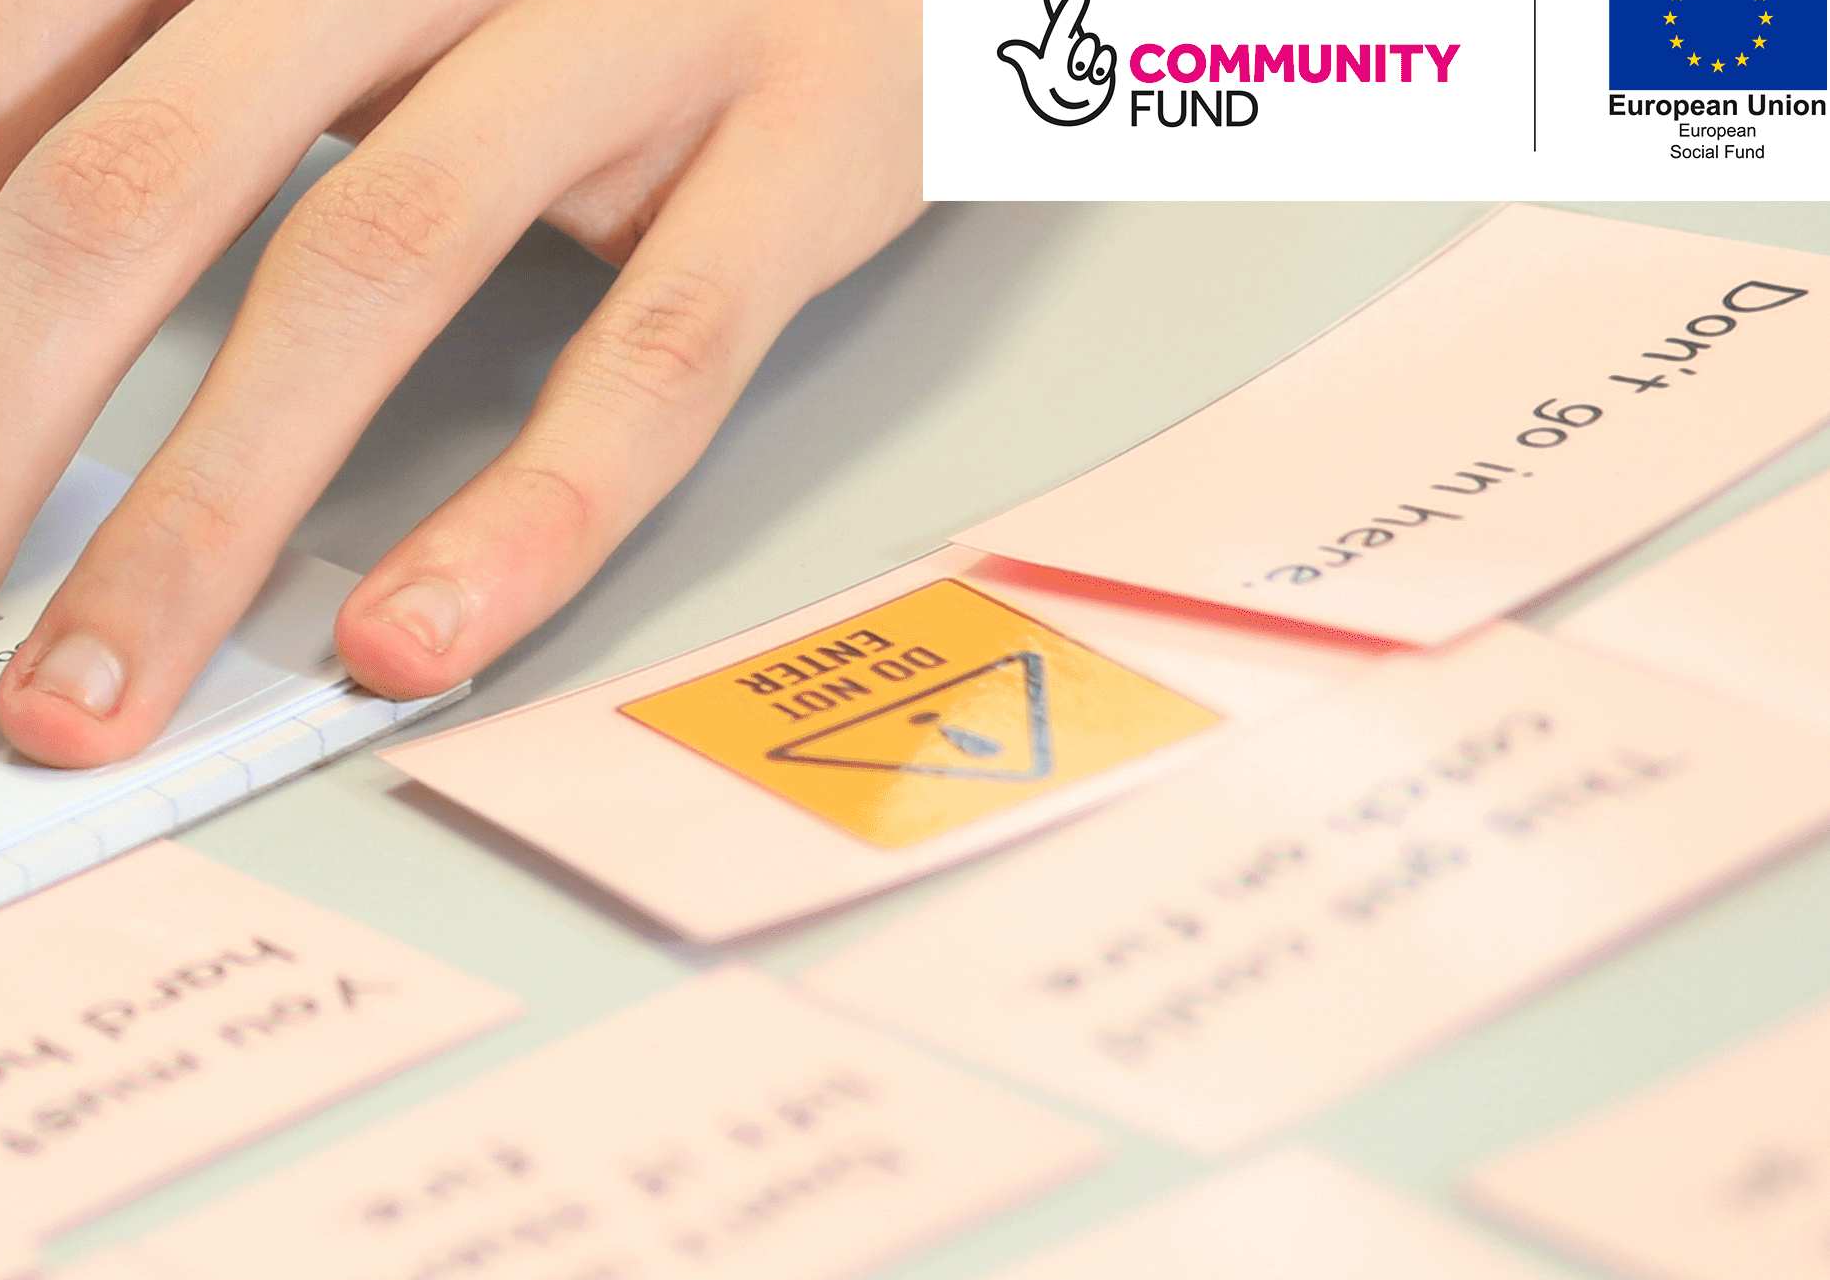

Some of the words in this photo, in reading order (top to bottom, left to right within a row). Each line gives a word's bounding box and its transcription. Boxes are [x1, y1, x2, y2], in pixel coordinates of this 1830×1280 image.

[1608, 280, 1809, 393] Don't
[1516, 398, 1603, 449] go
[1431, 461, 1533, 495] in
[1241, 504, 1464, 590] here.
[735, 630, 894, 695] ENTER
[869, 646, 948, 681] DO
[771, 676, 872, 723] NOT
[80, 935, 297, 1042] hard
[216, 973, 376, 1049] You
